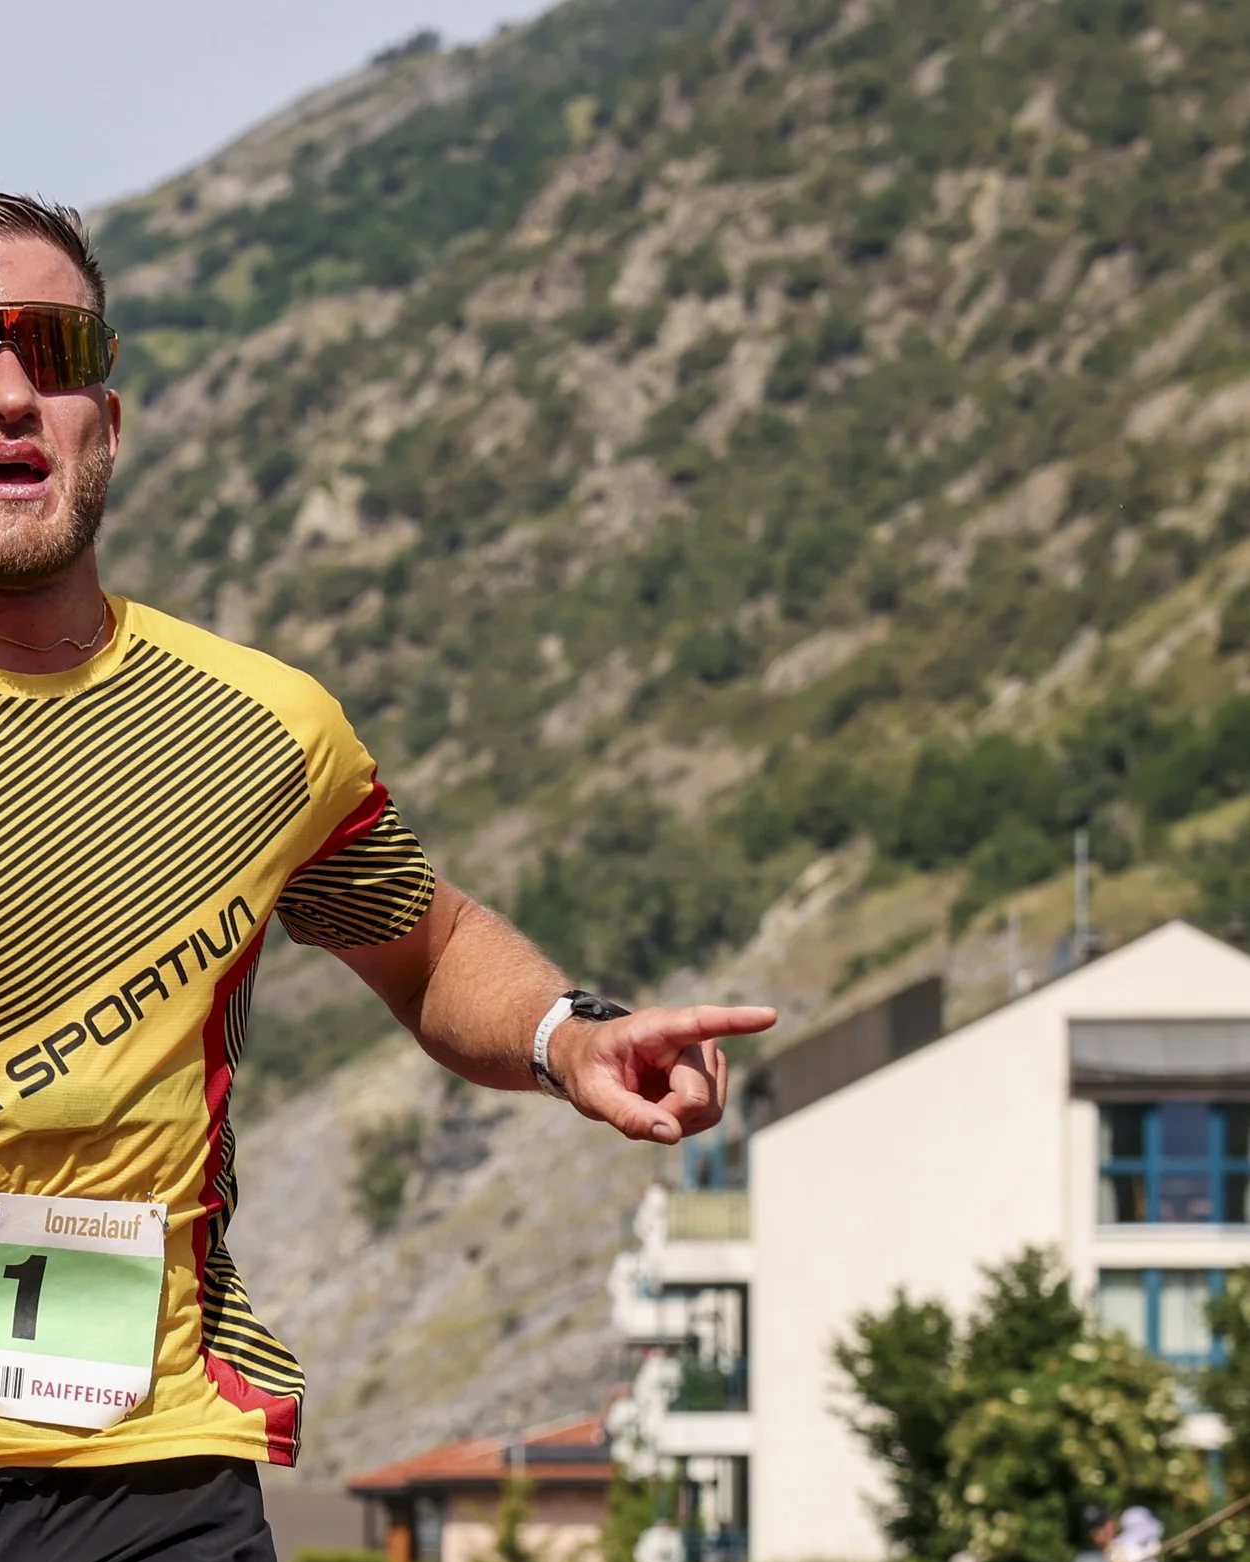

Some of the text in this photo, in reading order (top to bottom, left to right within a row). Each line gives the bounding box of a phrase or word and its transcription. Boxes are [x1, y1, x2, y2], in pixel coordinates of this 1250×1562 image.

[5, 895, 256, 1099] SPORTIVA
[44, 1208, 142, 1241] lonzalauf
[31, 1379, 138, 1408] RAIFFEISEN
